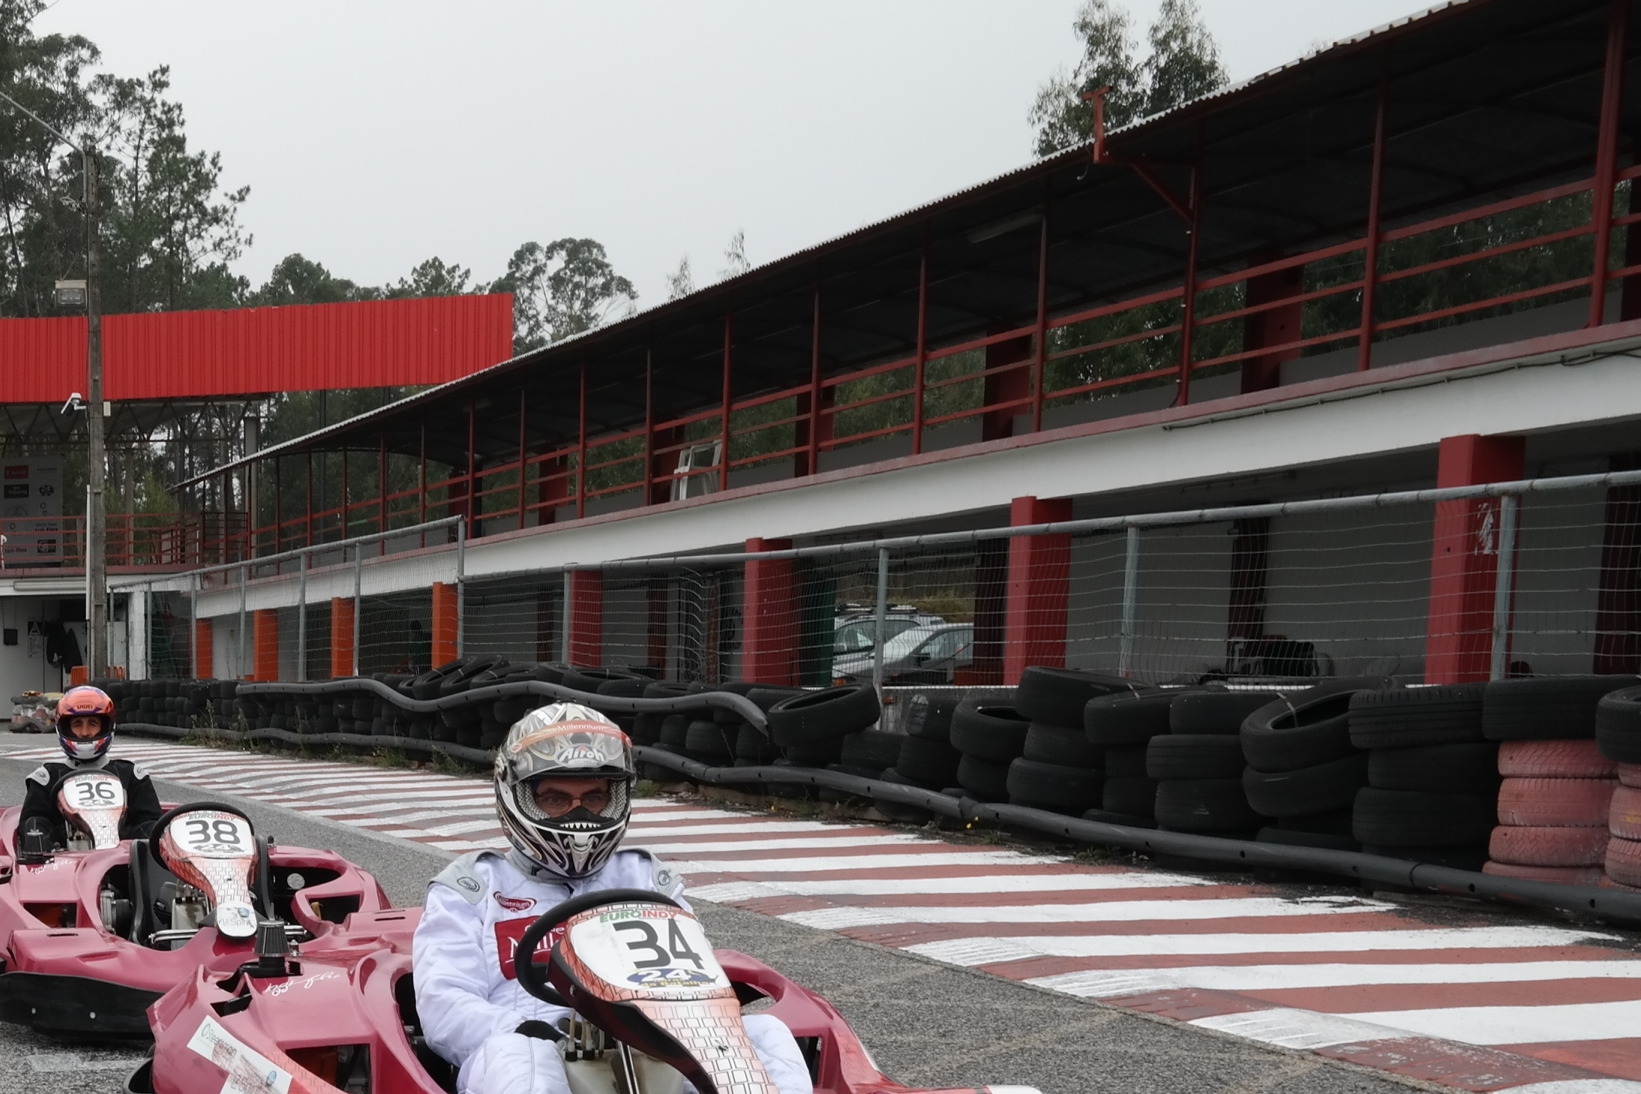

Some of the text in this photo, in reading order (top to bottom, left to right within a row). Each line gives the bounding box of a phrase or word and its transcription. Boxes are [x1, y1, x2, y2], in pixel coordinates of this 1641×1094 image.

[557, 723, 604, 732] Millennium
[559, 746, 605, 762] Airoh
[76, 781, 115, 801] 36
[185, 820, 241, 844] 38
[599, 910, 678, 923] EUROINDY
[612, 919, 705, 969] 34
[638, 969, 692, 982] 24
